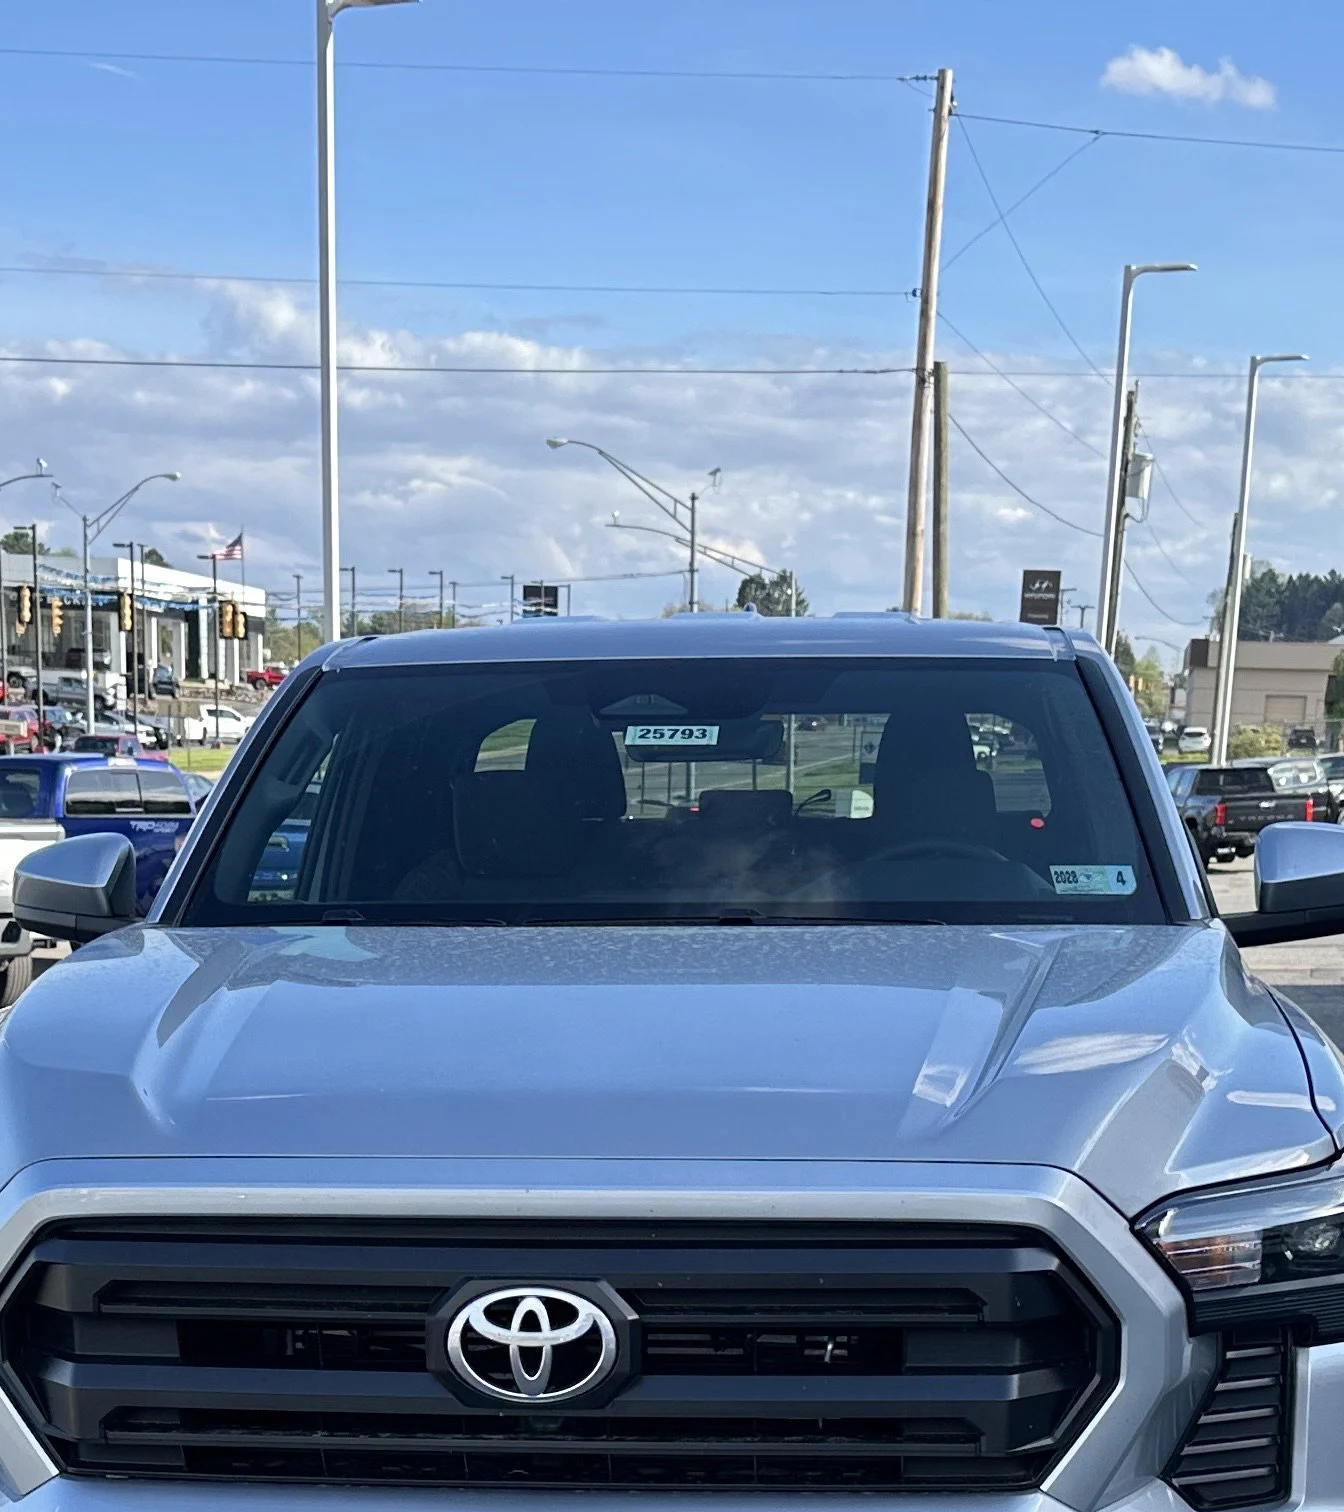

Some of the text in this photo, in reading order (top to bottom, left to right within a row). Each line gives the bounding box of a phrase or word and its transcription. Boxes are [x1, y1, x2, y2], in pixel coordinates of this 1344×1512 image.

[637, 728, 708, 740] 25793
[1053, 870, 1126, 886] 2028 4
